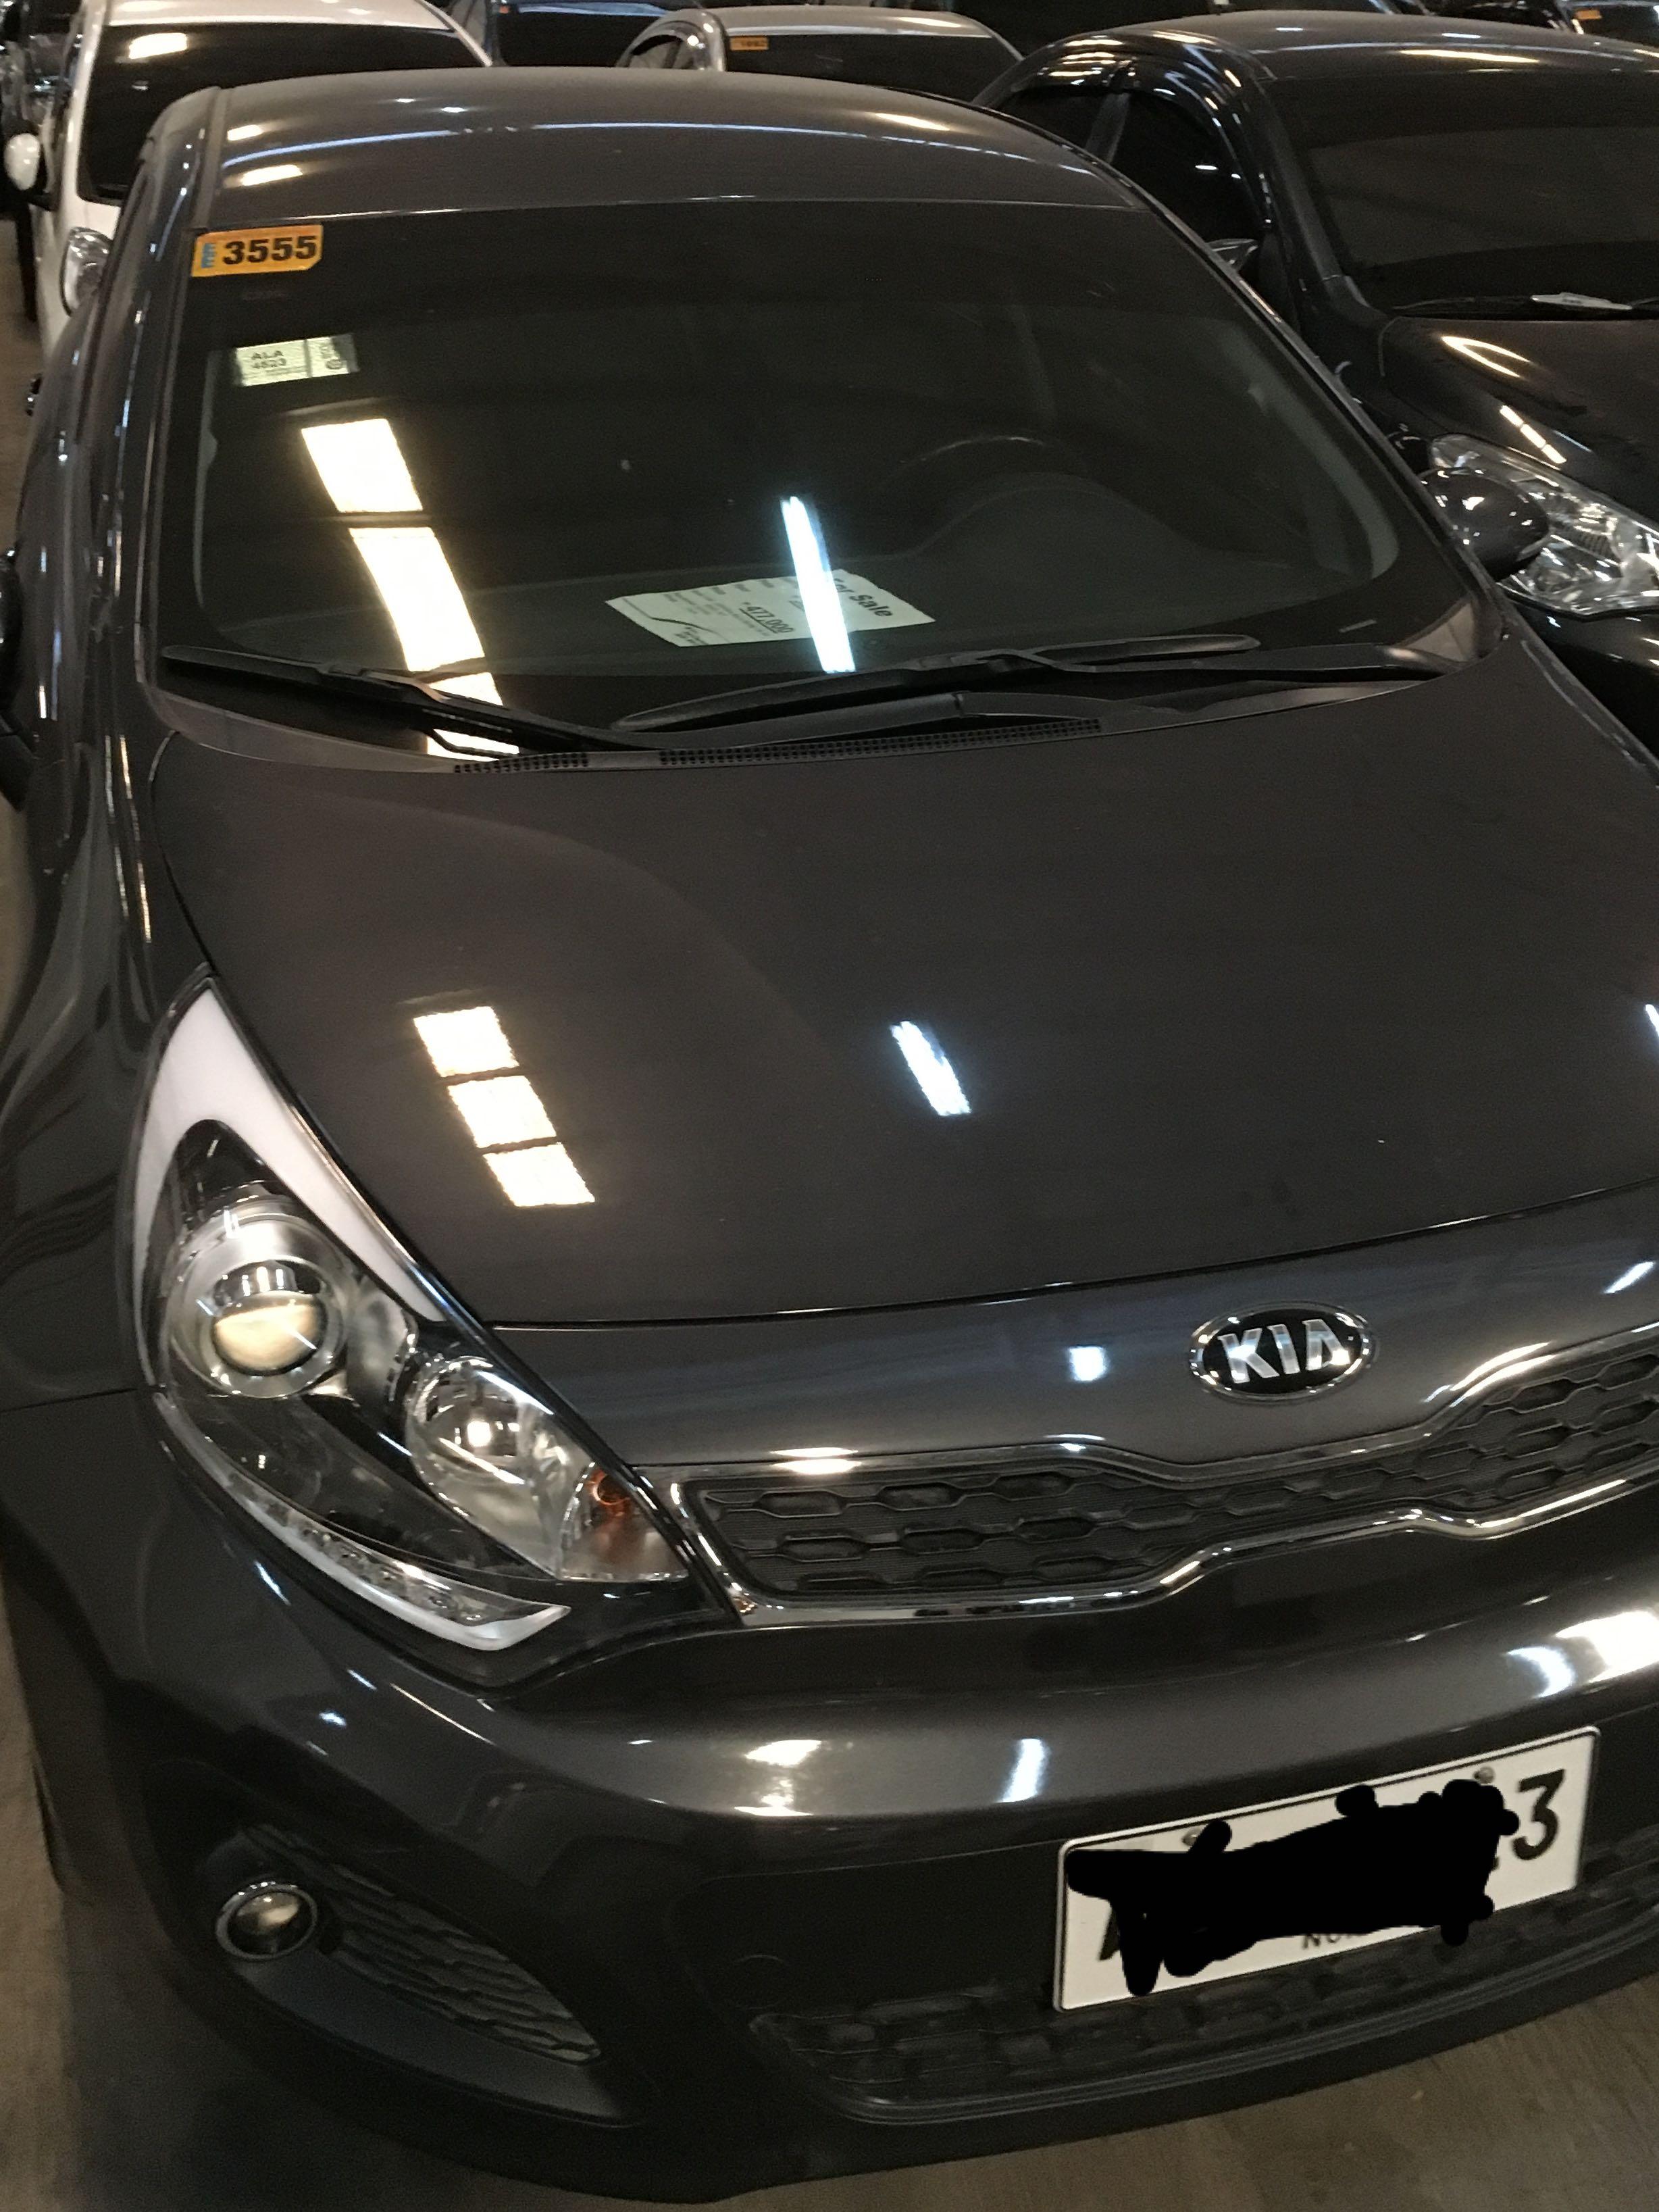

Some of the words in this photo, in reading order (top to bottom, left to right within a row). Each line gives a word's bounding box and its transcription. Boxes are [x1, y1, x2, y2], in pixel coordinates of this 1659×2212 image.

[223, 236, 316, 265] 3555
[848, 595, 893, 617] Sale
[1217, 1319, 1350, 1384] KIA
